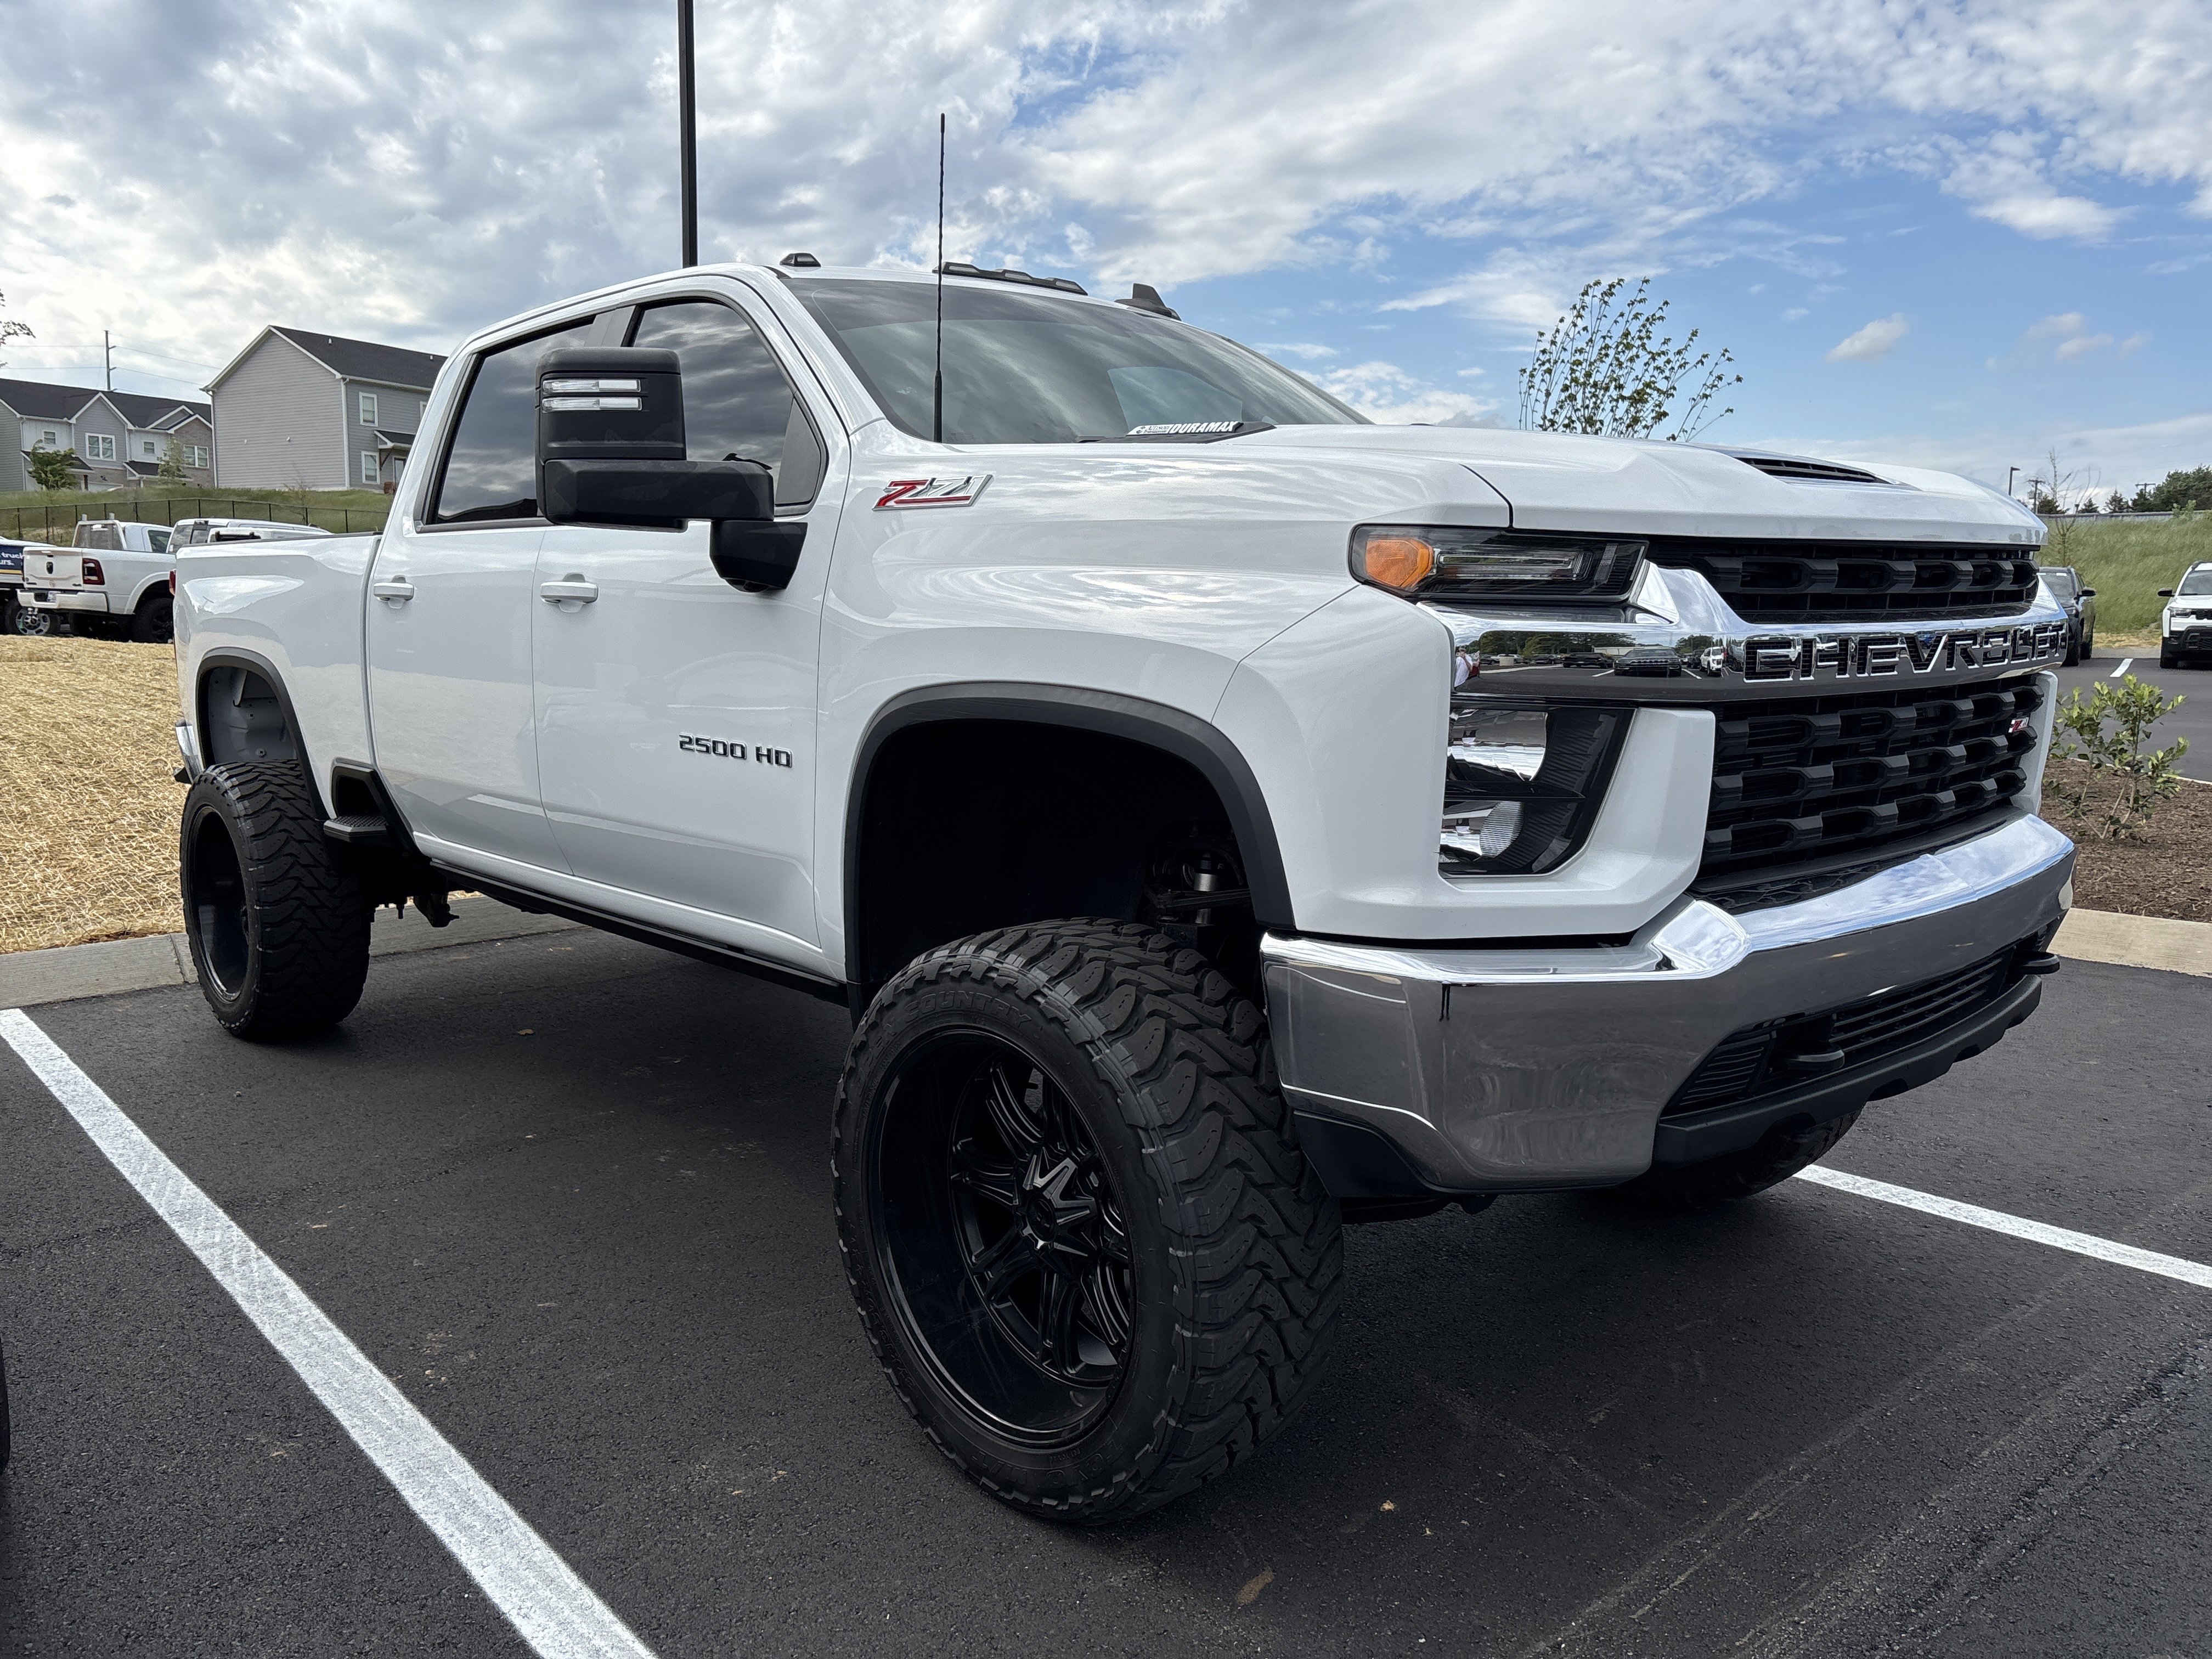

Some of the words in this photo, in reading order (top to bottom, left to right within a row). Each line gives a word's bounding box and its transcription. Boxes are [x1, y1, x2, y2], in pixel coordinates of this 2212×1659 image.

[1169, 421, 1239, 434] DURAMAX
[873, 474, 994, 511] Z71
[1743, 622, 2066, 683] CHEVROLET
[679, 732, 747, 760] 2500
[755, 743, 793, 768] HD
[905, 990, 1032, 1028] COUNTRY
